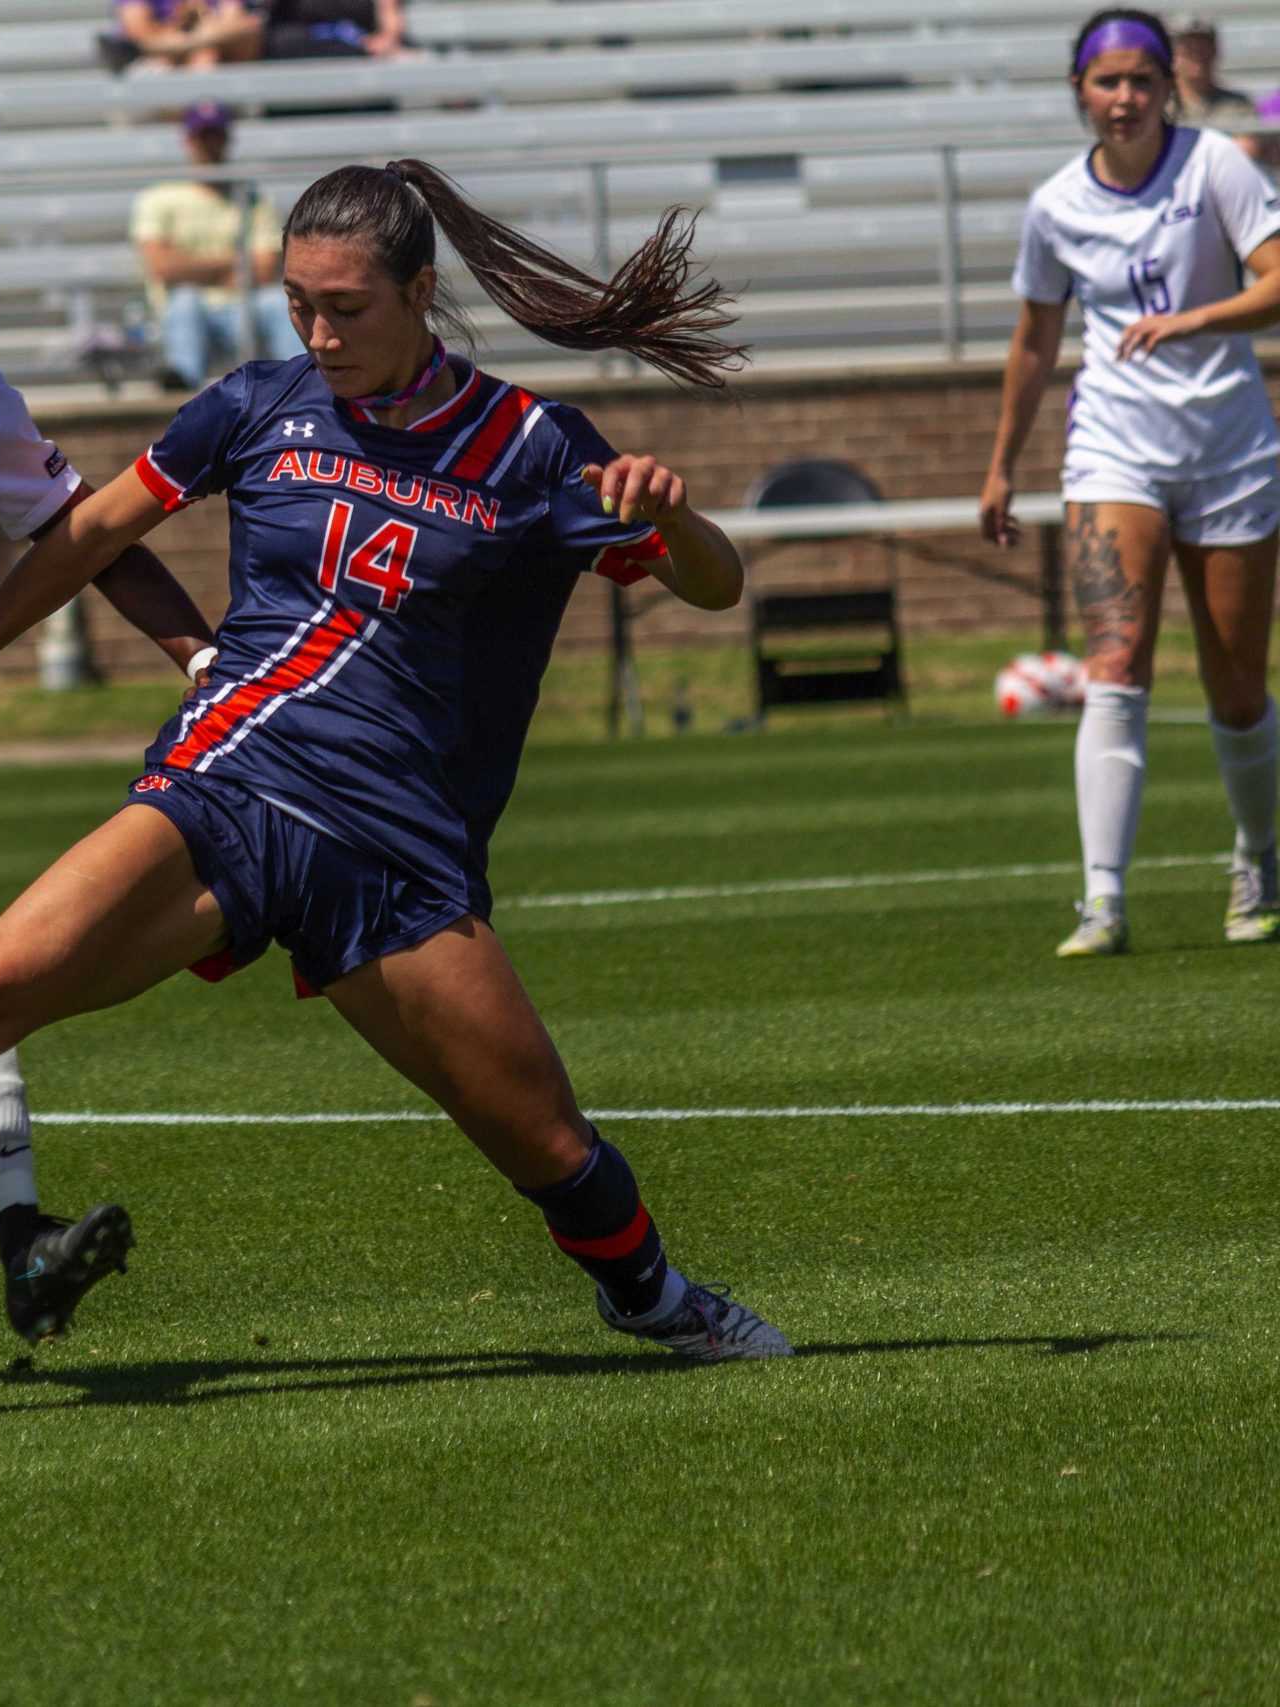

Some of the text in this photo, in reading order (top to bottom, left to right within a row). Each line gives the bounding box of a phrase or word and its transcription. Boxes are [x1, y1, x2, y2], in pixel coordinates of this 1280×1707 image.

[1128, 257, 1171, 316] 15
[267, 449, 502, 533] AUBURN
[318, 498, 419, 614] 14
